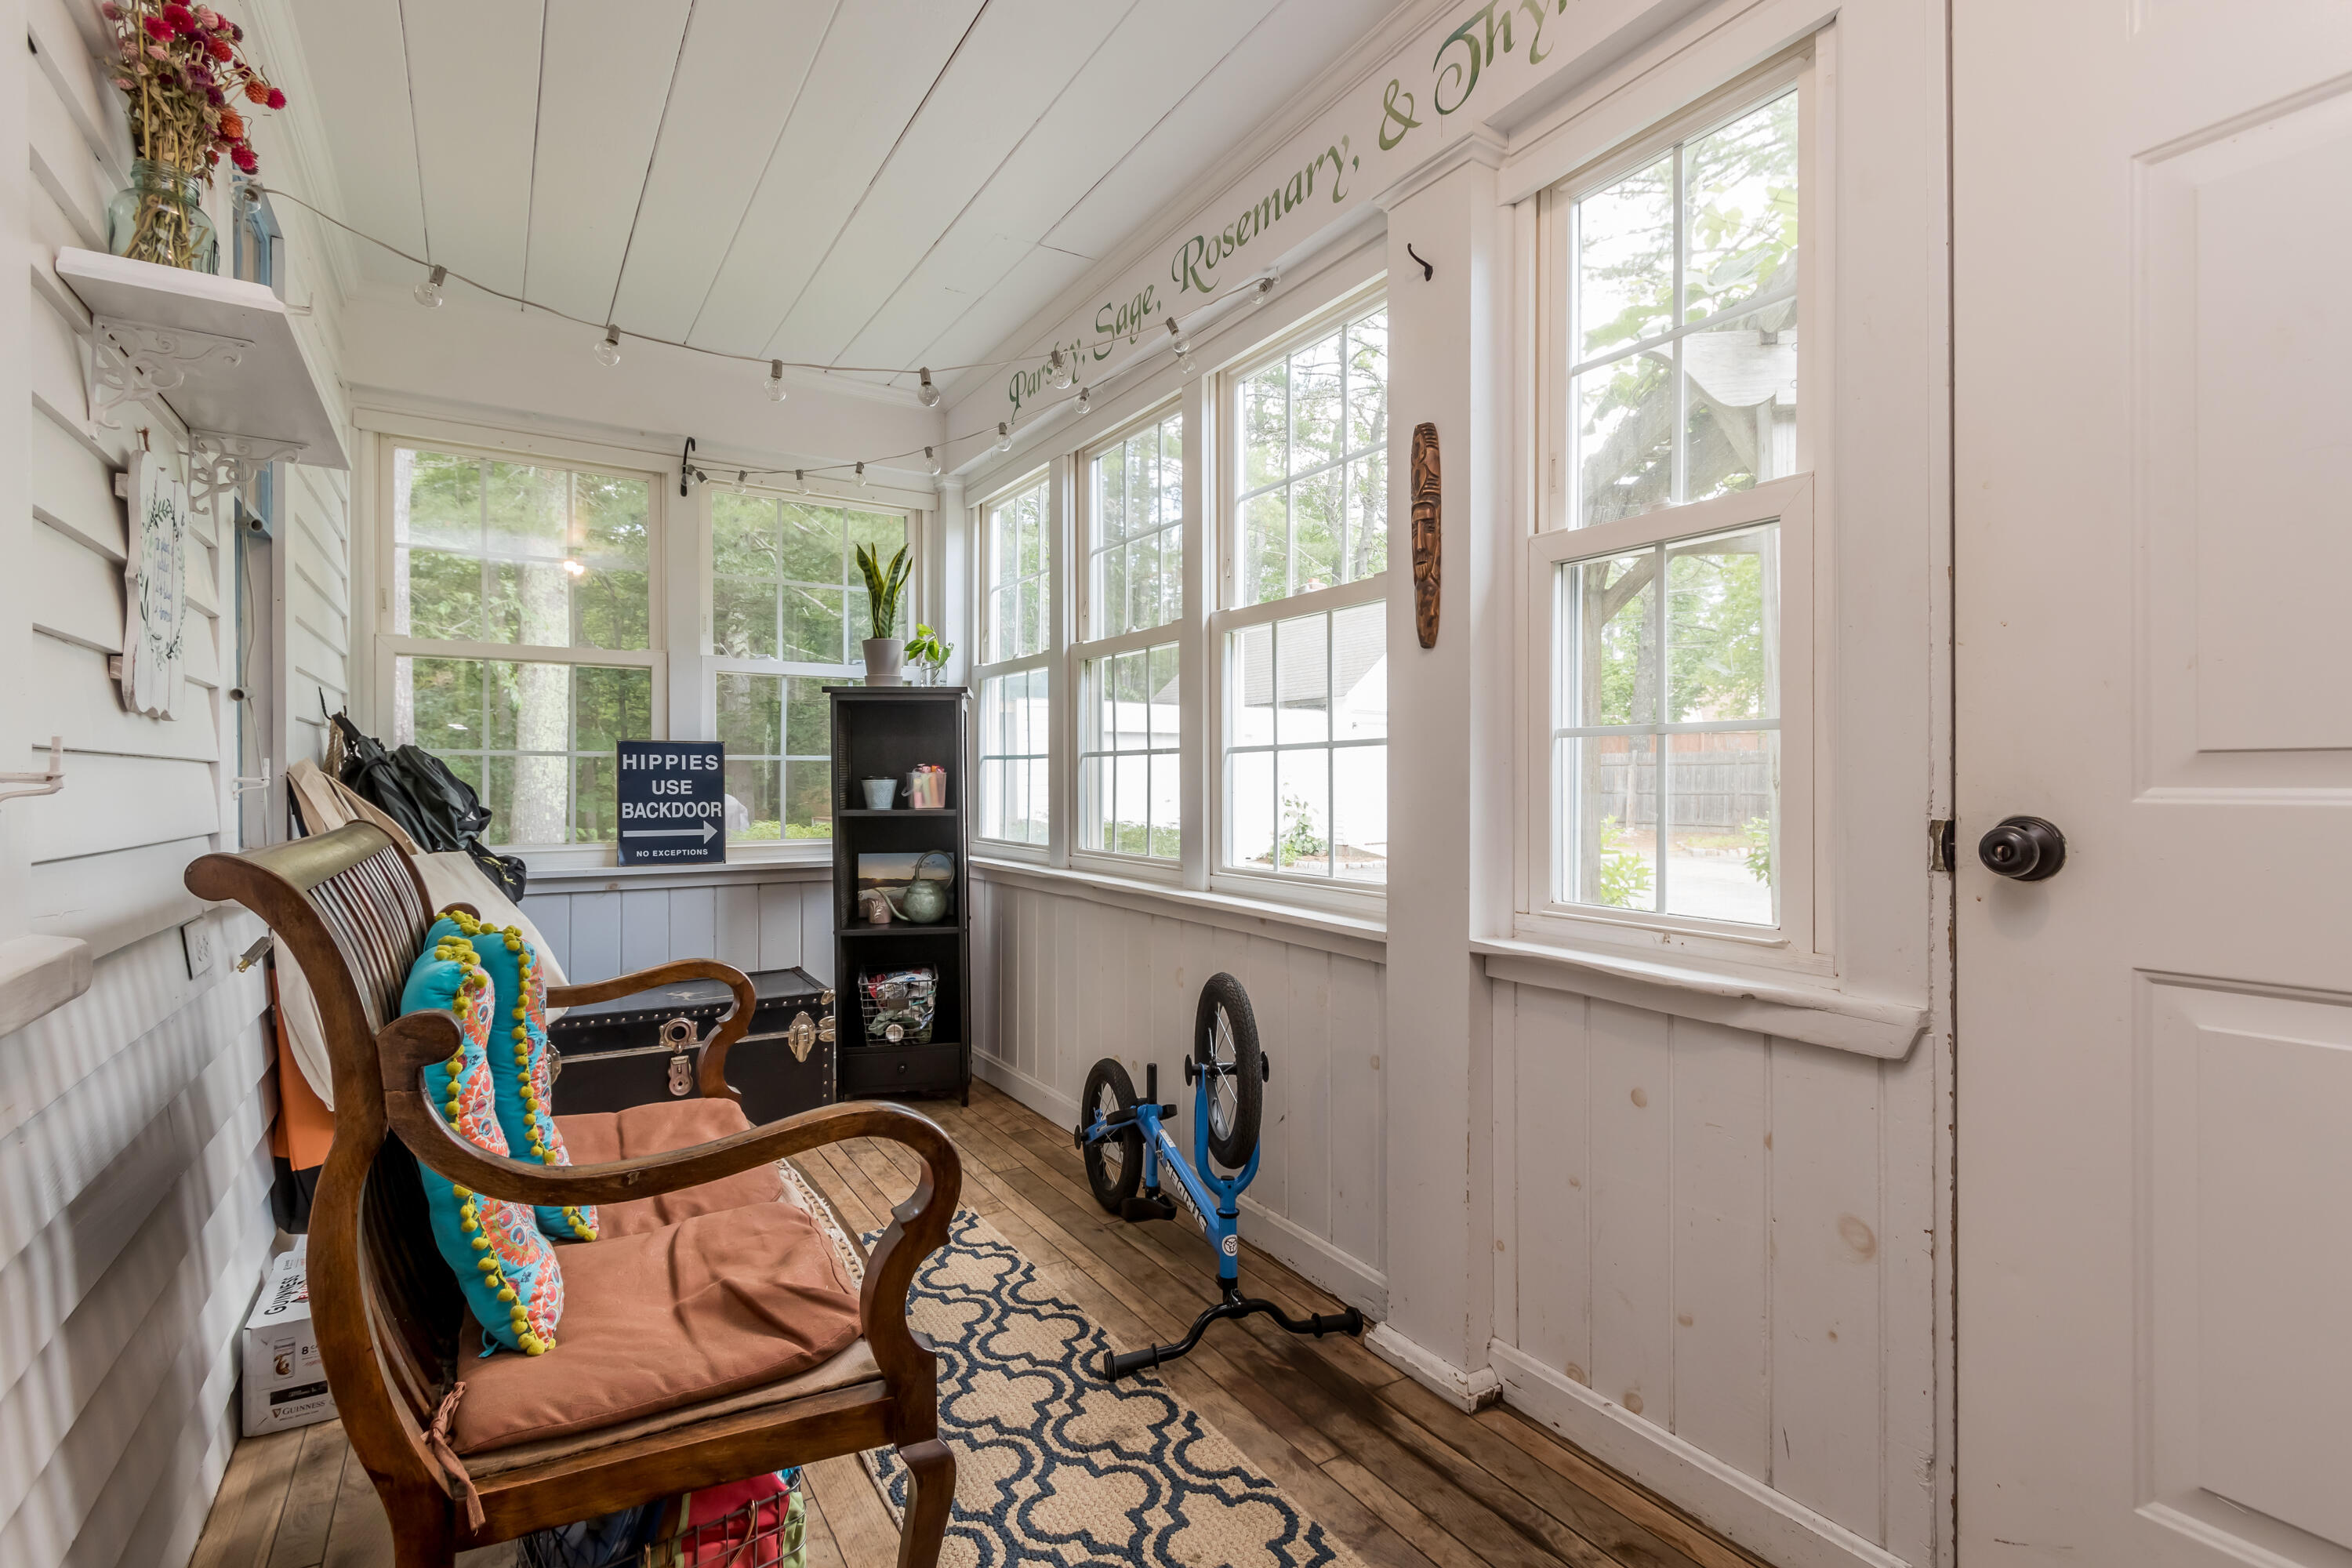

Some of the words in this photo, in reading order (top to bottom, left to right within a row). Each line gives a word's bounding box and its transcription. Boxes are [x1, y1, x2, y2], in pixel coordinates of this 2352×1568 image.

[1009, 338, 1086, 425] Parsy,
[1093, 284, 1161, 361] Sage,
[1171, 134, 1360, 294] Rosemary,
[1378, 78, 1423, 151] &
[1432, 0, 1581, 115] Thy
[622, 753, 719, 771] HIPPIES
[652, 779, 693, 795] USE
[622, 801, 722, 818] BACKDOOR
[652, 848, 709, 857] EXCEPTIONS
[1164, 1158, 1209, 1234] STRIDER
[263, 1274, 300, 1316] GUINNESS
[301, 1346, 309, 1355] 8
[281, 1399, 326, 1415] GUINNESS
